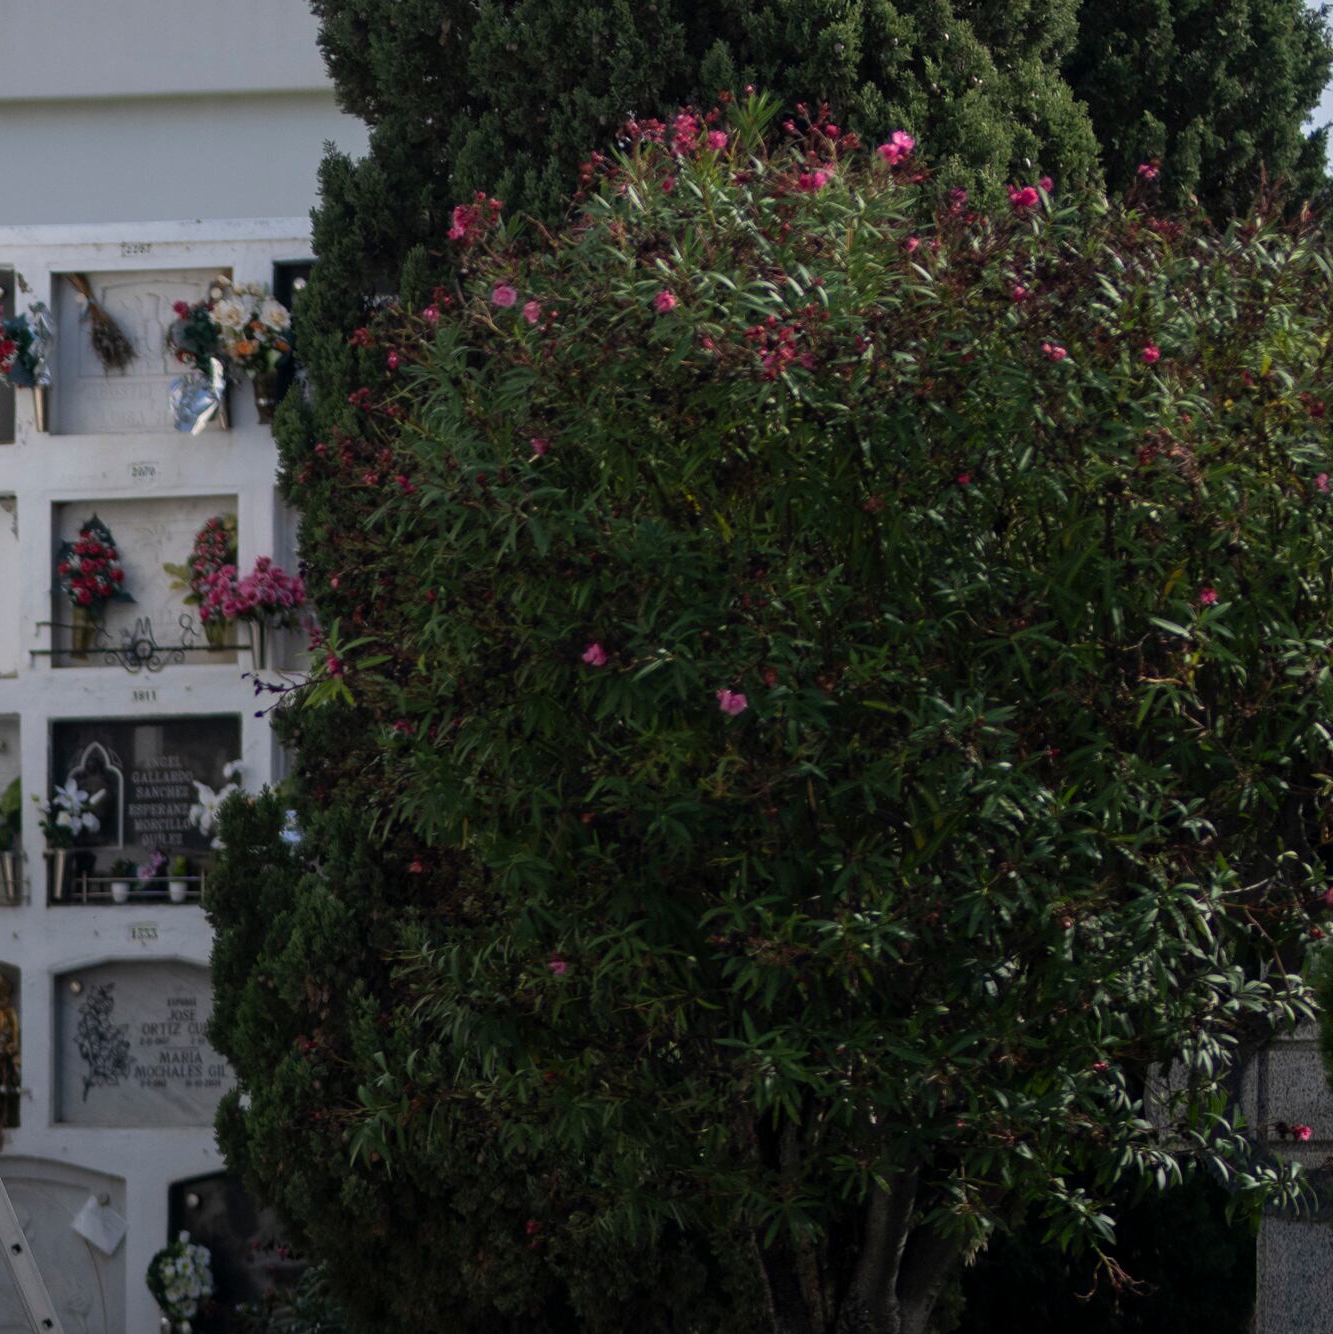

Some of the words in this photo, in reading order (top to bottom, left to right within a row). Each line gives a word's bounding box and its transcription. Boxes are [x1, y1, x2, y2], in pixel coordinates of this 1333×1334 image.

[128, 802, 191, 817] ESPERANZ
[141, 1021, 183, 1036] ORTIZ
[159, 1050, 204, 1064] MARIA
